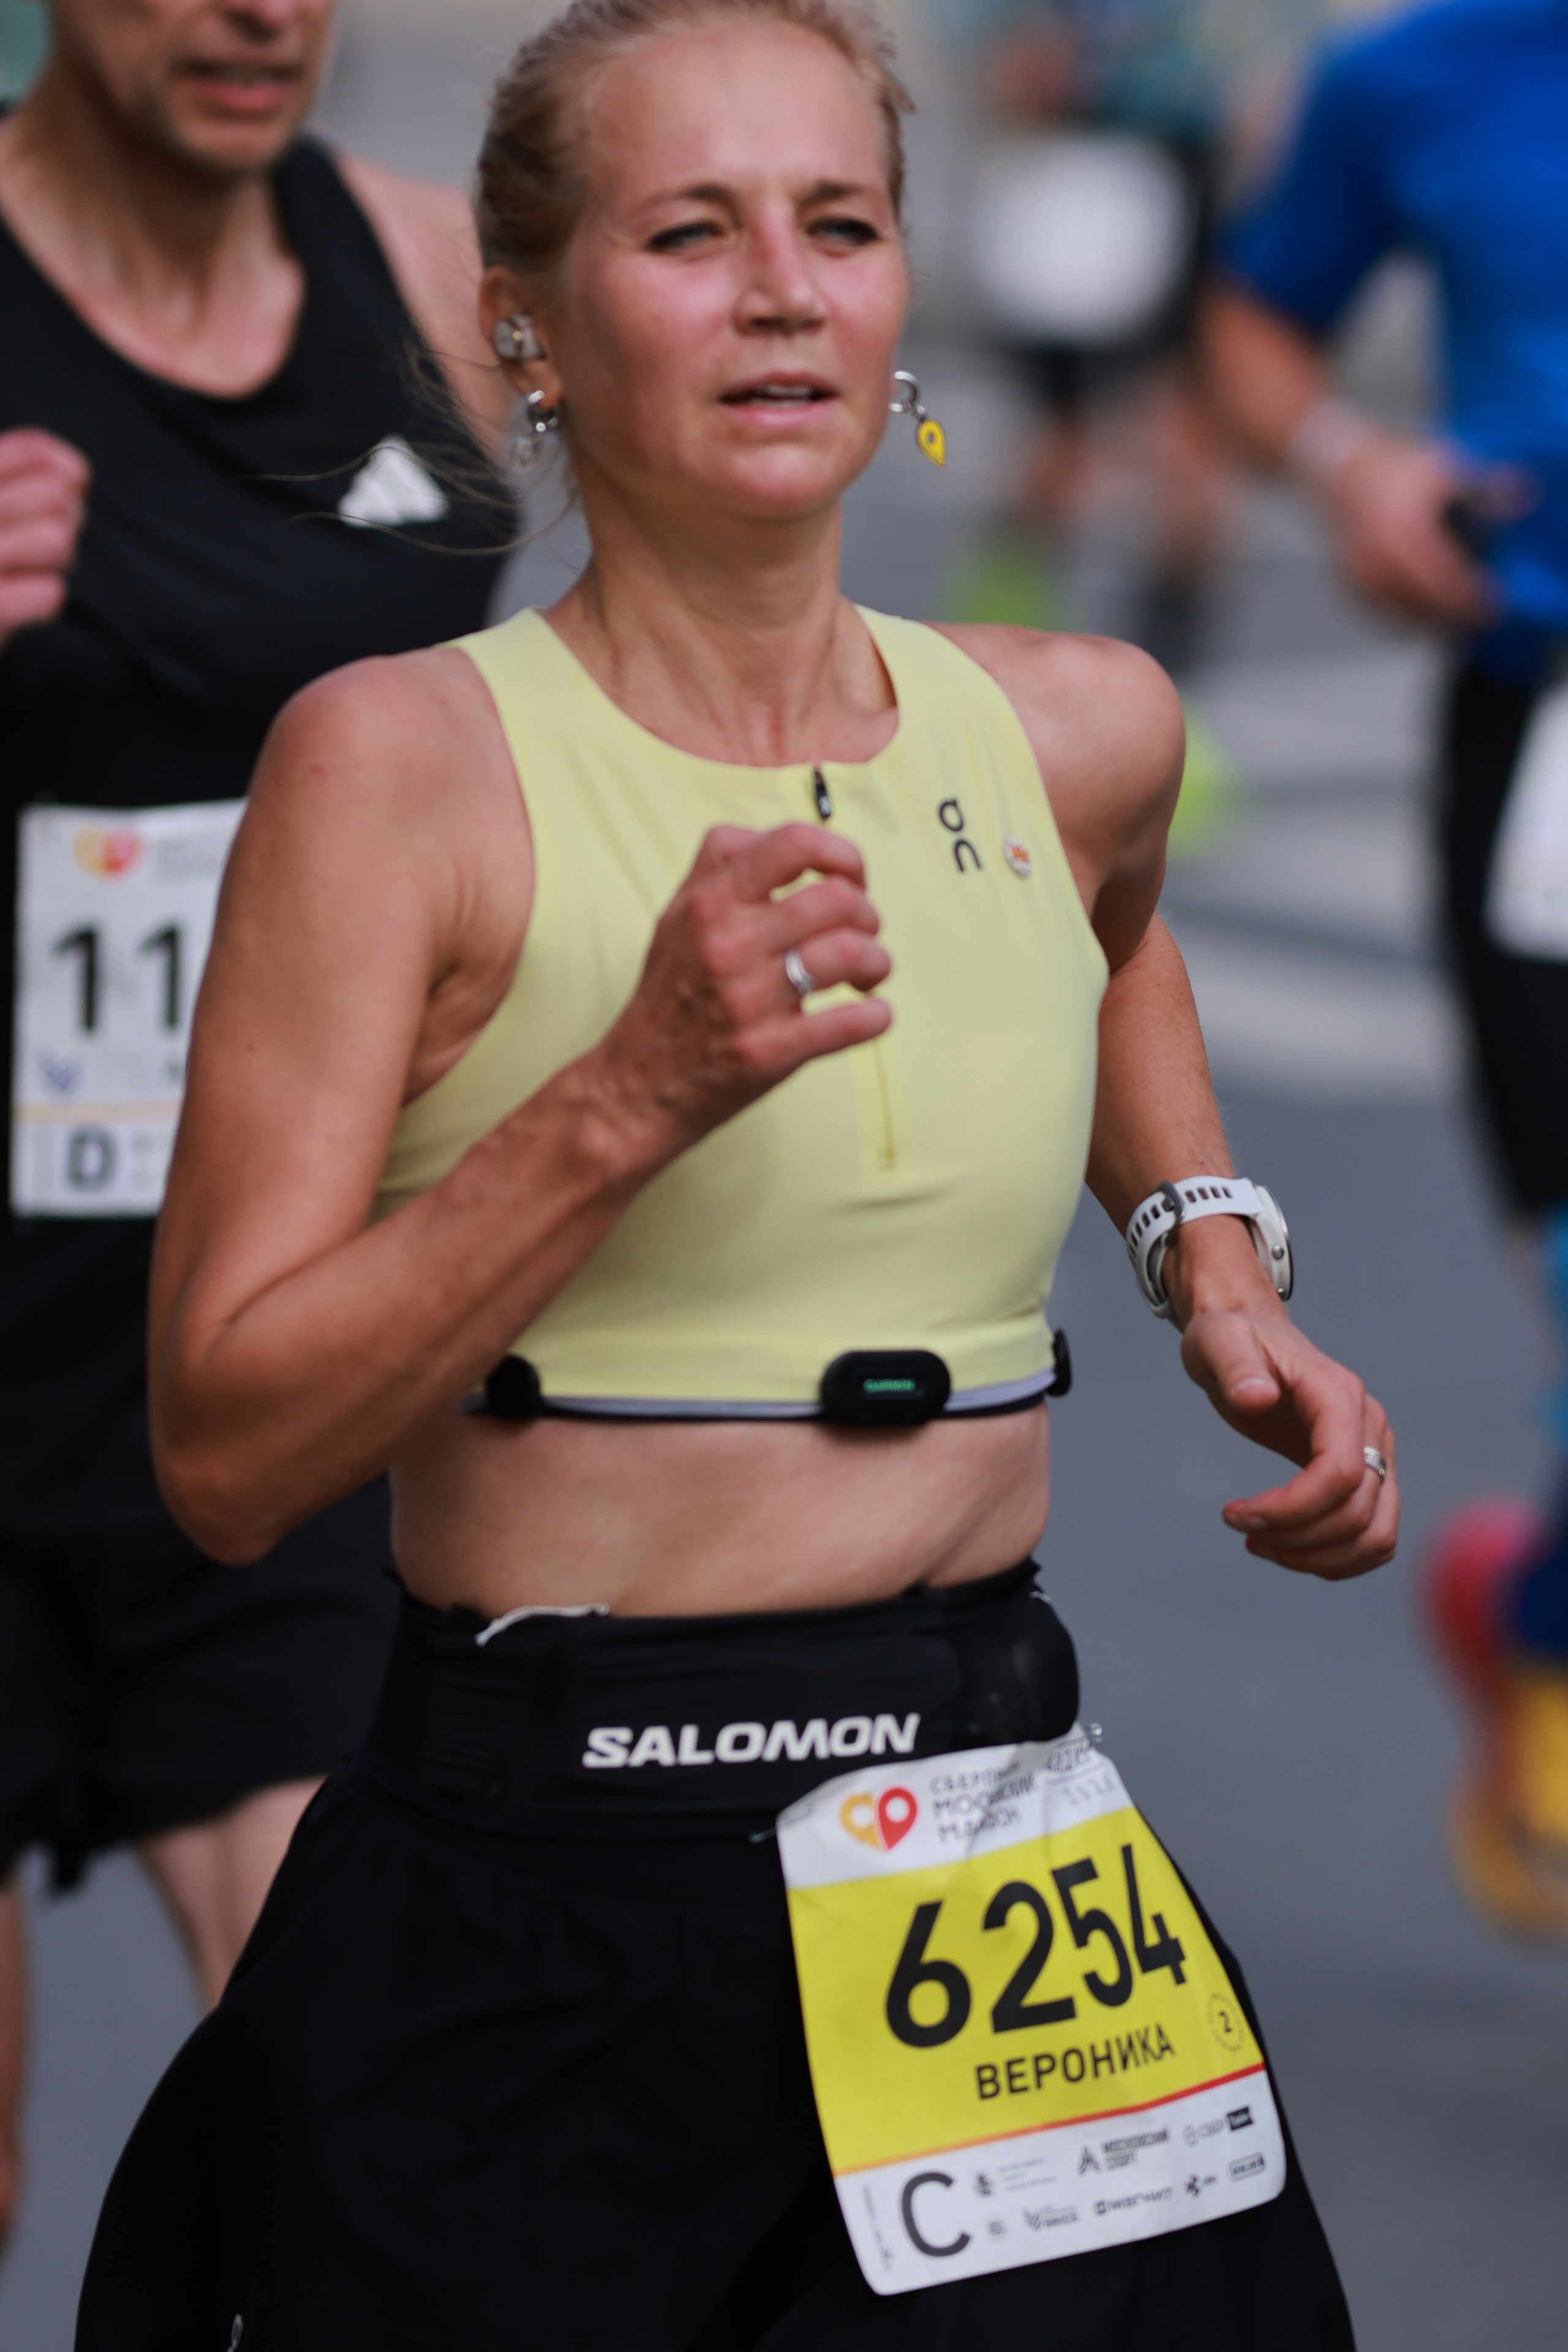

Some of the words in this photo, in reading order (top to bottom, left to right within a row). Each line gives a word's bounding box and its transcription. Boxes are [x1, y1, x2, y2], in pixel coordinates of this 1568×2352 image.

[67, 1126, 117, 1192] D
[582, 1713, 921, 1769] SALOMON
[886, 1843, 1186, 2049] 6254
[1218, 2010, 1233, 2034] 2
[975, 2024, 1175, 2100] ВЕРОНИКА
[900, 2171, 971, 2258] C
